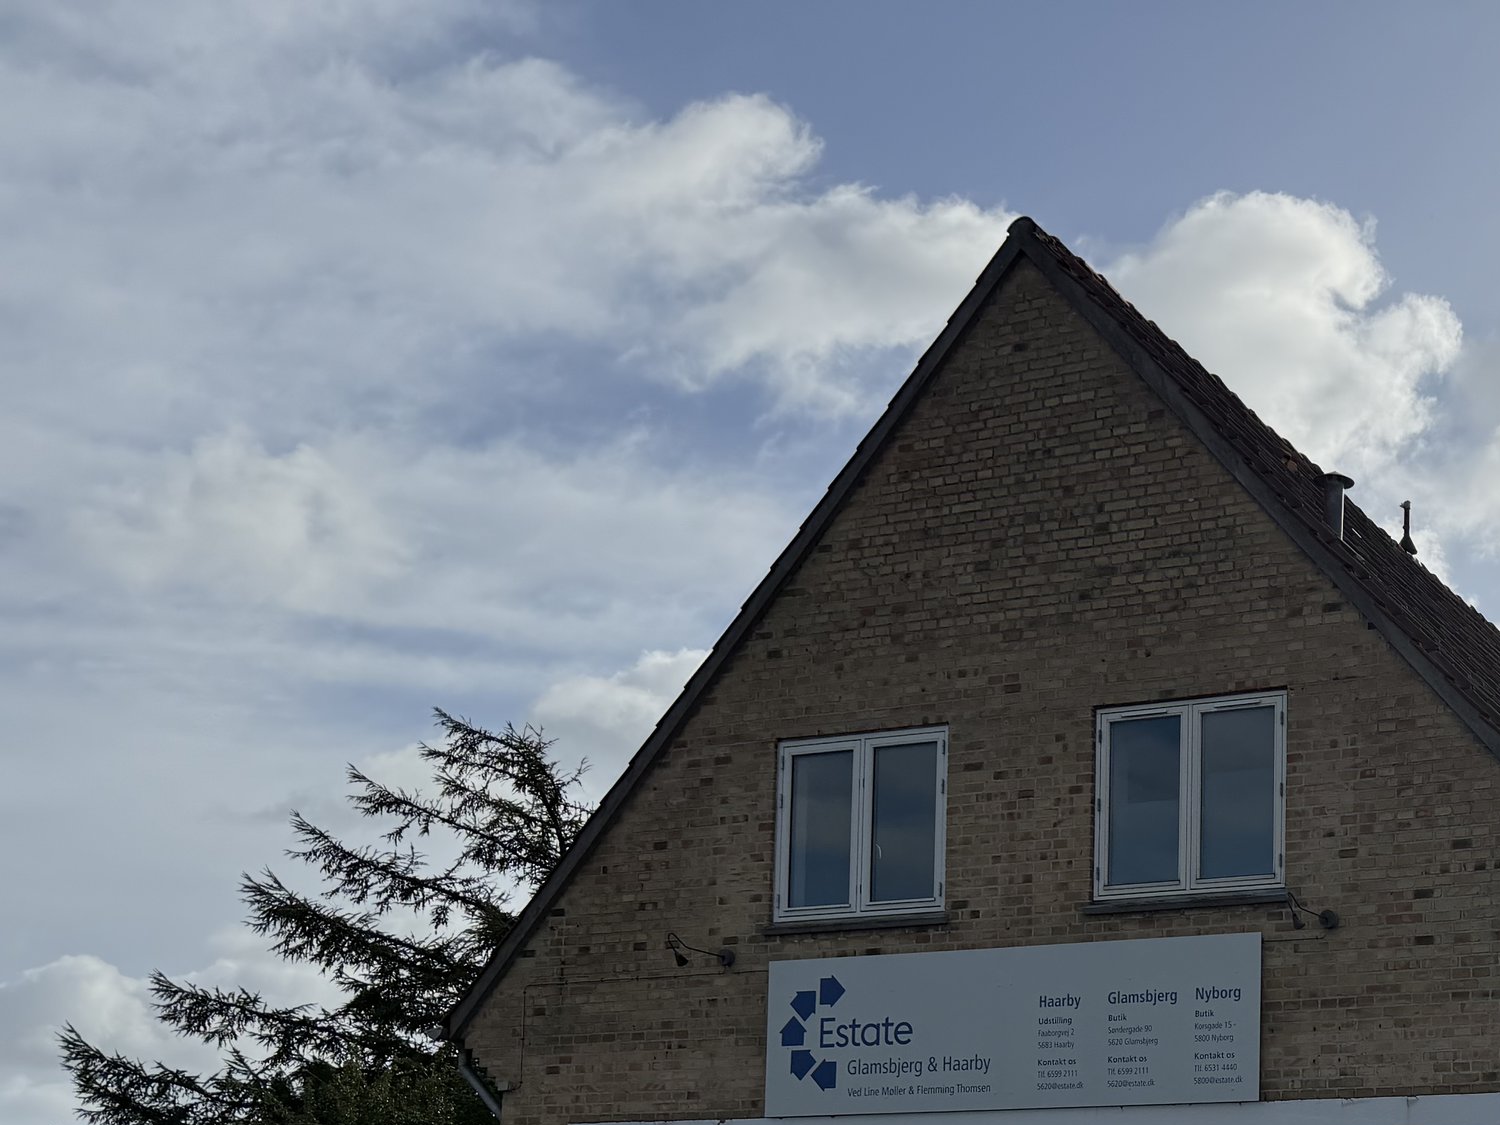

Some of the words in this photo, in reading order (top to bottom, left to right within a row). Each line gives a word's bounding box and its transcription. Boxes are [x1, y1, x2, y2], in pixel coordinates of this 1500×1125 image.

[1108, 989, 1177, 1005] Glamsbjerg
[1196, 986, 1241, 1002] Nyborg
[1039, 994, 1081, 1010] Haarby
[1039, 1017, 1072, 1026] Udstilling
[1195, 1022, 1223, 1031] Korsgade
[820, 1017, 913, 1048] Estate
[1125, 1037, 1158, 1046] Glamsbjerg
[1211, 1034, 1234, 1043] Nyborg
[1038, 1058, 1066, 1066] Kontakt
[1108, 1056, 1137, 1064] Kontakt
[848, 1058, 923, 1078] Glamsbjerg
[927, 1058, 938, 1071] &
[943, 1054, 990, 1074] Haarby
[848, 1088, 862, 1097] Ved
[864, 1087, 879, 1096] Line
[881, 1086, 906, 1096] Møller
[917, 1085, 954, 1095] Flemming
[957, 1084, 991, 1093] Thomsen
